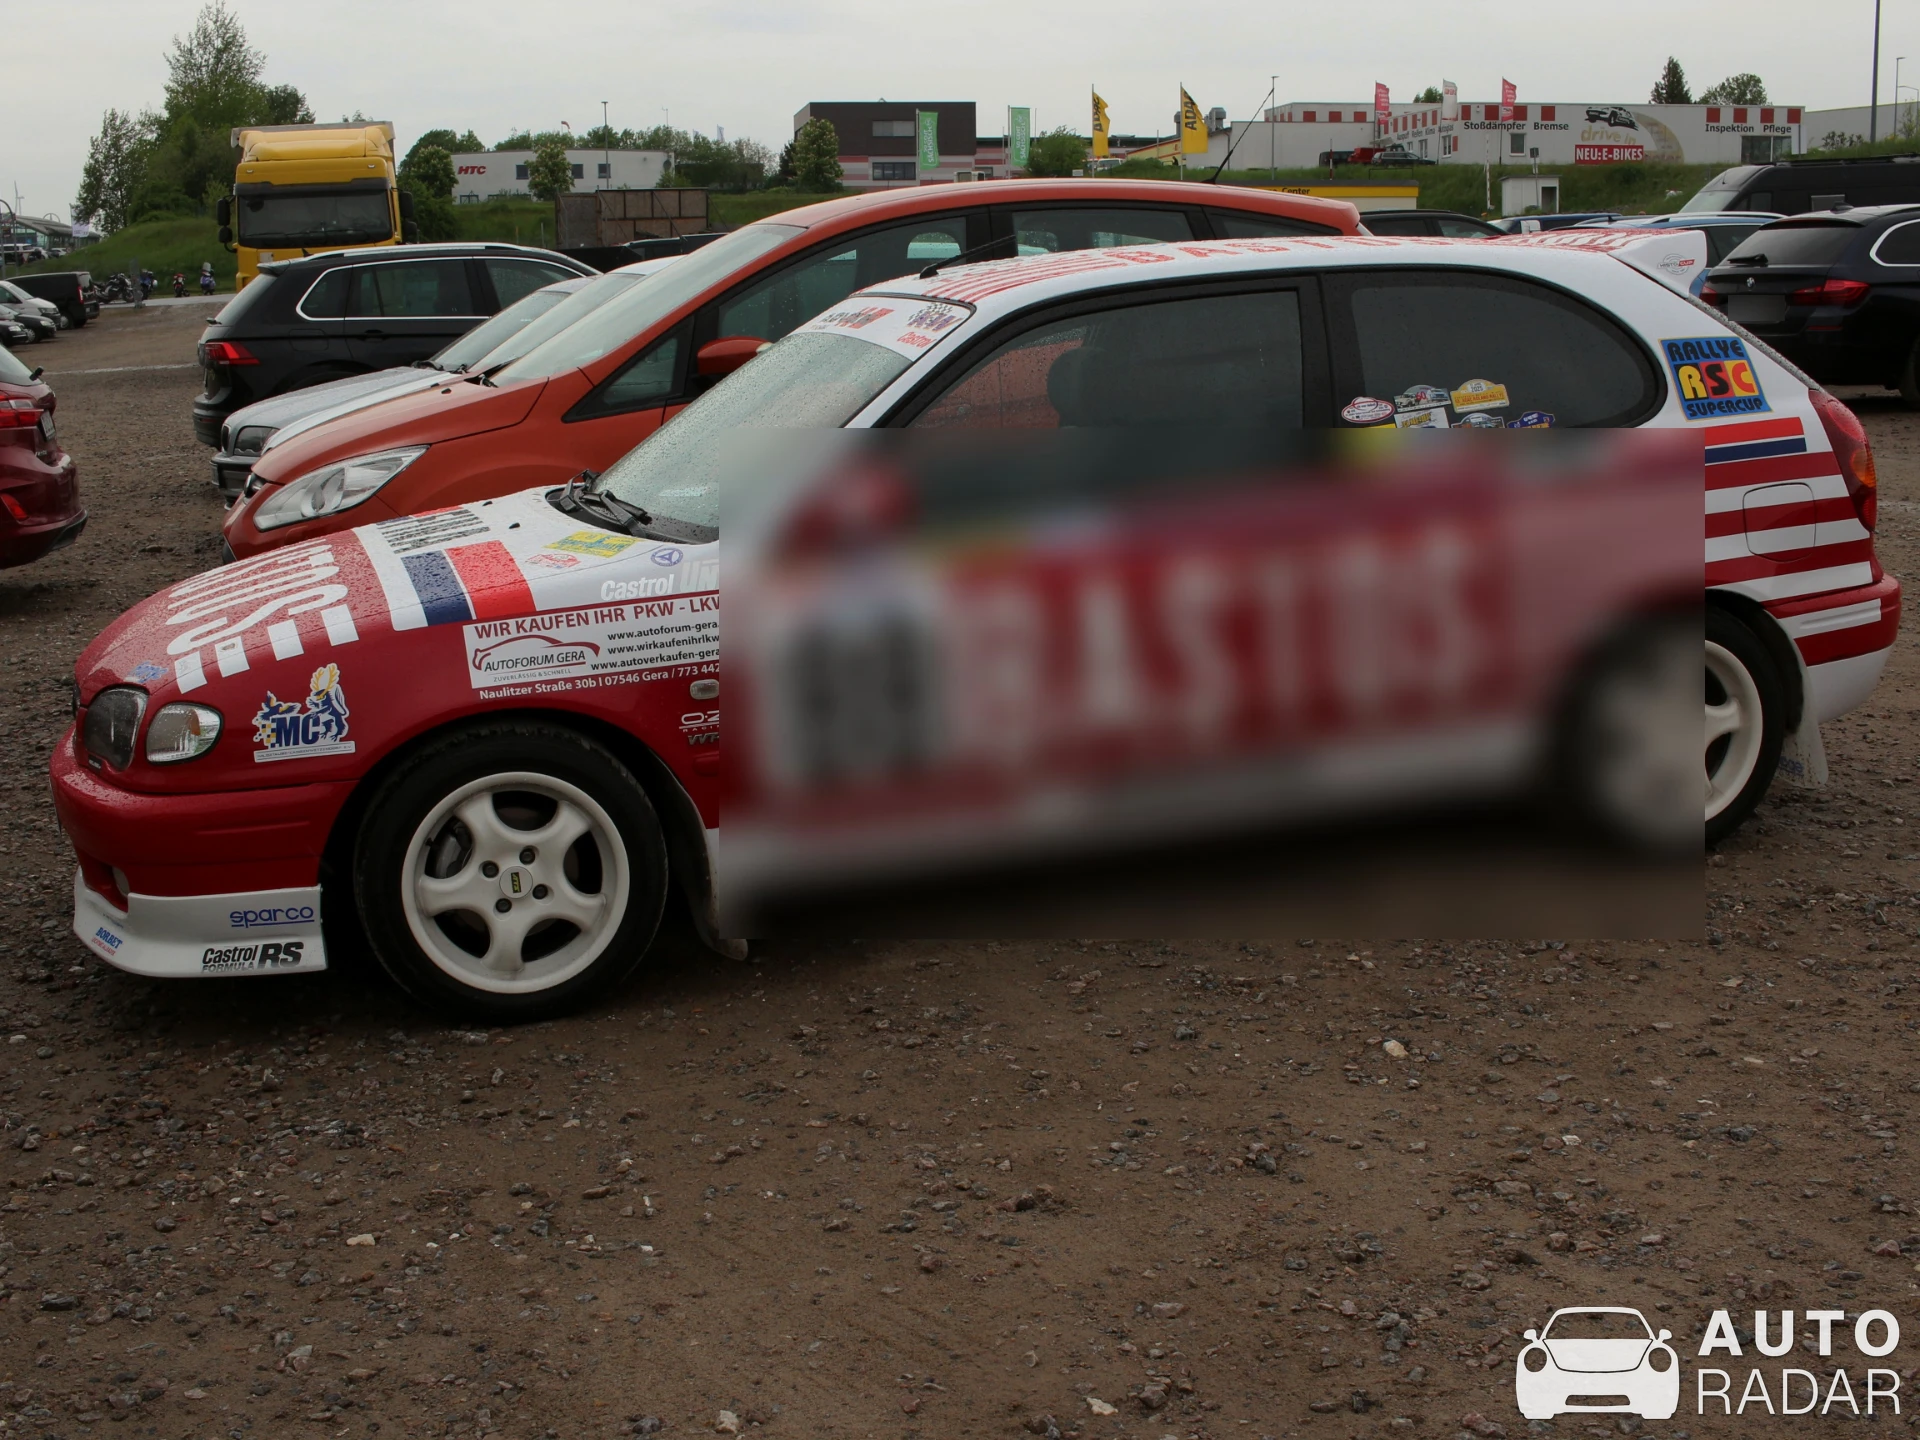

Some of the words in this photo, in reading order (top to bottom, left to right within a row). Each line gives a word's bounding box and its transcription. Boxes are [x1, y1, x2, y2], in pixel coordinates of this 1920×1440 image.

[1464, 121, 1525, 131] Stoßdämpfer
[1534, 122, 1569, 130] Bremse
[1581, 125, 1621, 142] drive
[1705, 124, 1754, 134] Inspektion
[1763, 125, 1791, 134] Pflege
[458, 165, 486, 175] HTC
[1282, 187, 1310, 195] Center
[1667, 339, 1744, 361] RALLYE
[1678, 361, 1756, 400] RSC
[1687, 398, 1764, 417] SUPERCUP
[601, 573, 674, 601] Castrol
[474, 622, 512, 640] WIR
[515, 611, 590, 633] KAUFEN
[594, 607, 626, 624] IHR
[633, 601, 674, 619] PKW
[484, 654, 554, 672] AUTOFORUM
[556, 650, 585, 663] GERA
[480, 686, 532, 700] Naulitzer
[535, 680, 573, 693] Straße
[575, 678, 596, 689] 30b
[604, 673, 640, 686] 07546
[642, 671, 669, 681] Gera
[671, 668, 676, 678] /
[677, 666, 699, 677] 773
[543, 668, 572, 677] SCHNELL
[276, 714, 321, 748] MC
[230, 906, 315, 928] sparco
[96, 927, 123, 949] BORBET
[202, 944, 258, 966] Castrol
[258, 942, 304, 968] RS
[202, 962, 255, 973] FORMULA
